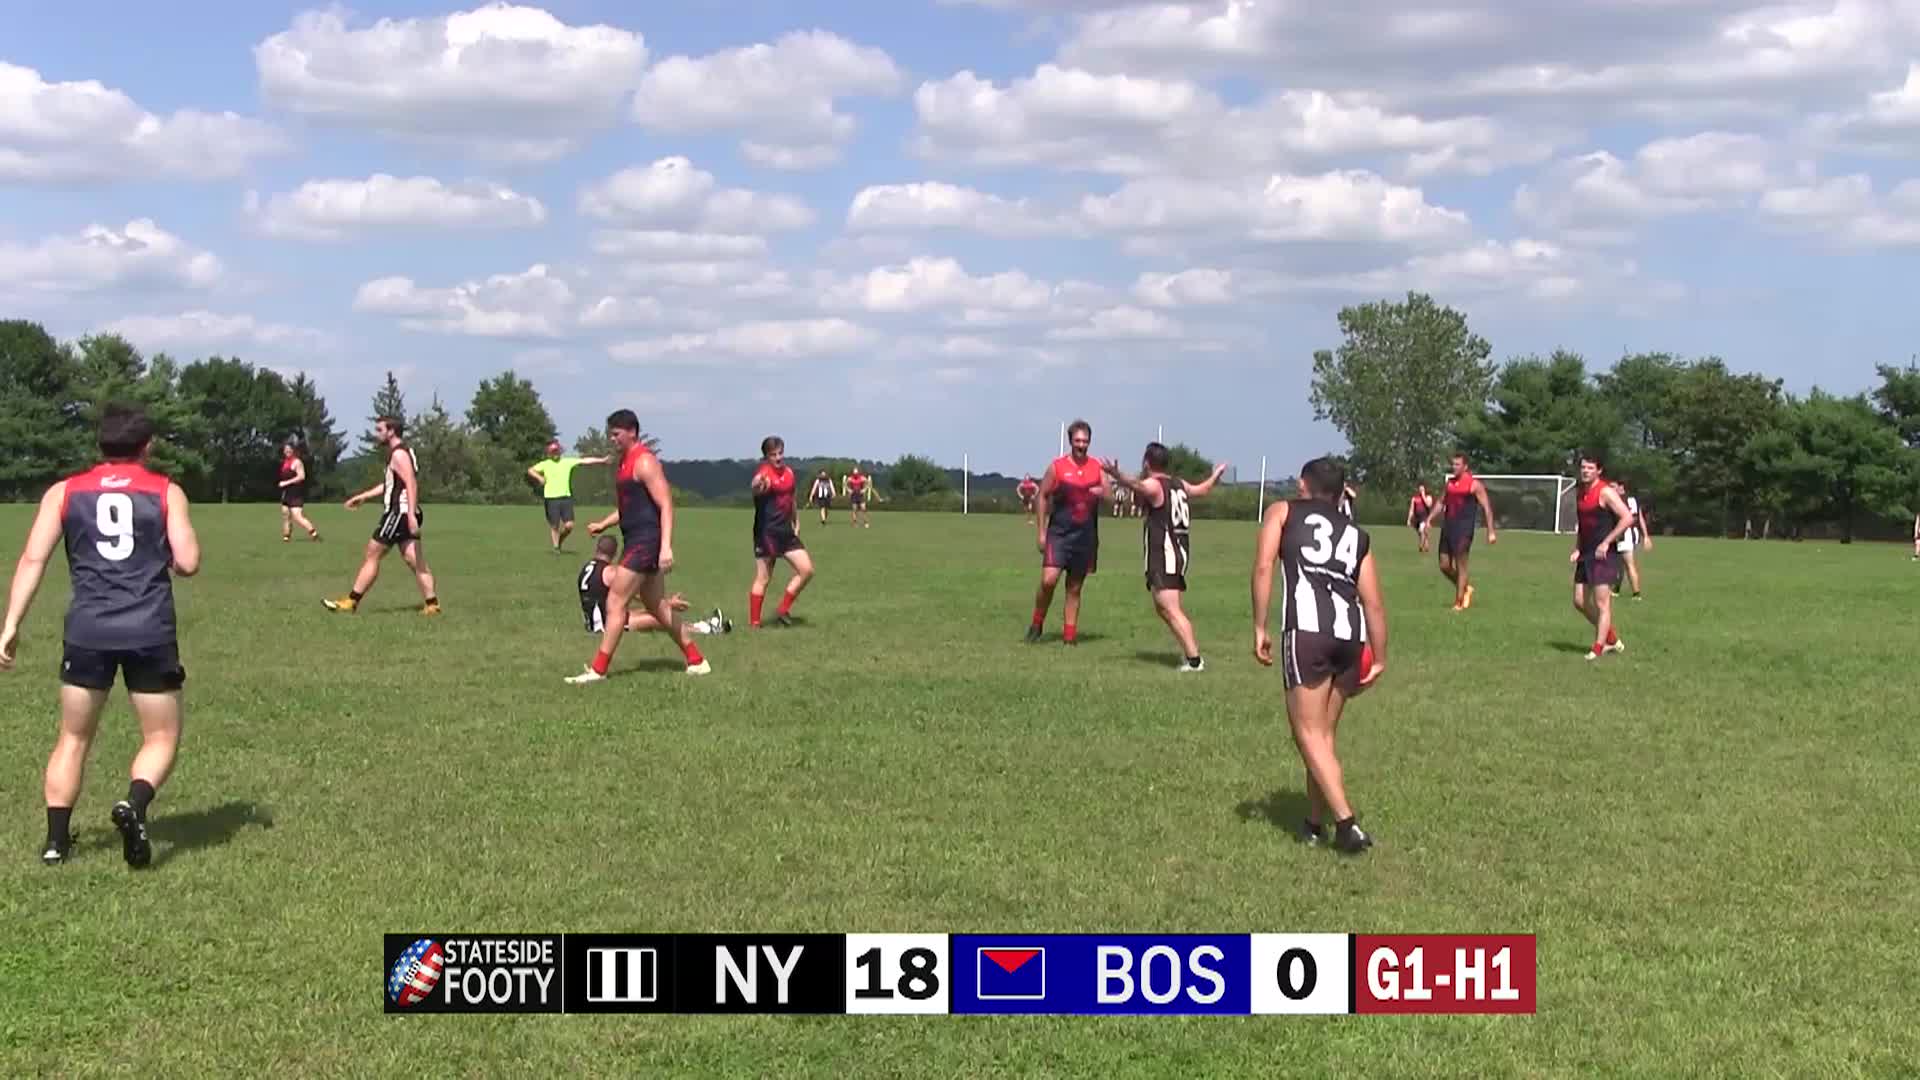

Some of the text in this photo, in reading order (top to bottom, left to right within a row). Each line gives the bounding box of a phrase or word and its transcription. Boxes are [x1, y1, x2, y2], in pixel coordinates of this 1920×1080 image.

[96, 493, 135, 561] 9
[1300, 513, 1359, 576] 34
[581, 564, 595, 590] 2
